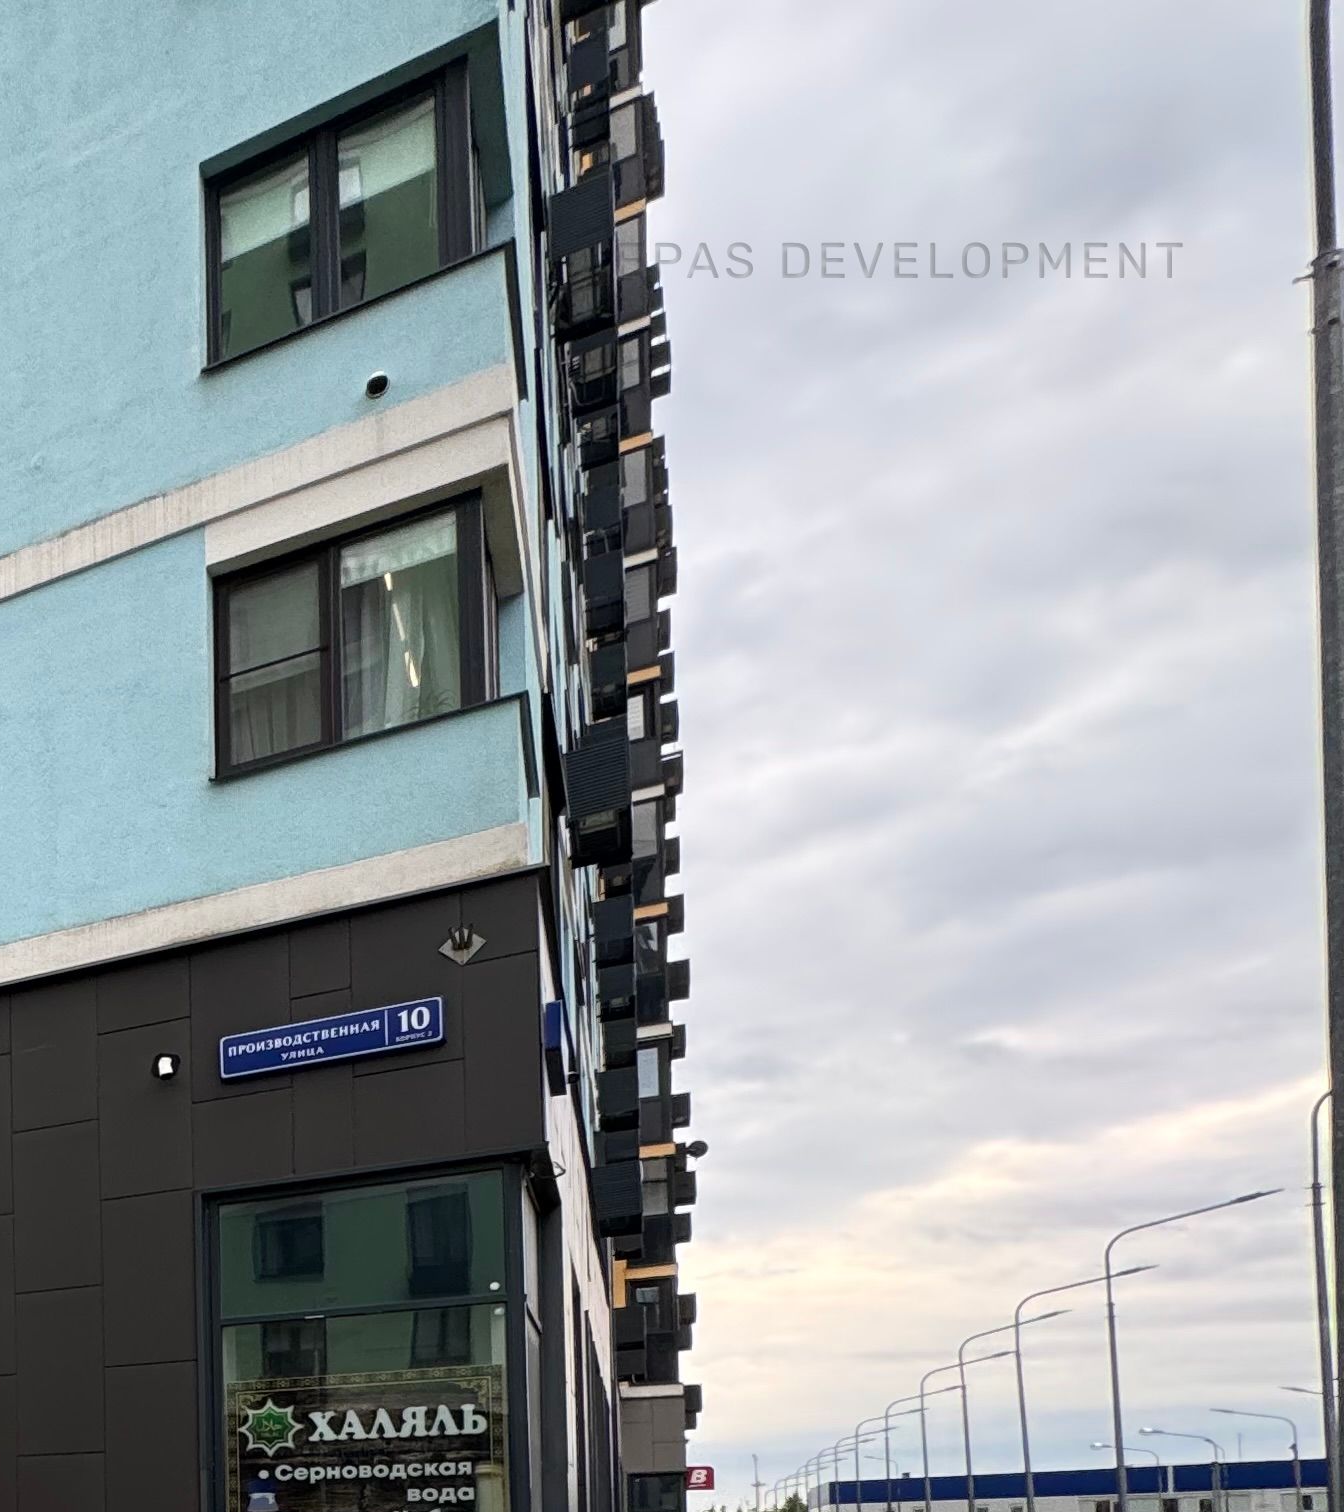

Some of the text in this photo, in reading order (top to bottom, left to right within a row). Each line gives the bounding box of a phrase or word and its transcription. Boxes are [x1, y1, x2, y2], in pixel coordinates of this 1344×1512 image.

[397, 1006, 431, 1033] 10
[227, 1019, 381, 1057] ПРОИЗВОДСТВЕННАЯ
[281, 1046, 325, 1061] УЛИЦА
[308, 1403, 489, 1442] ХАЛЯЛЬ
[274, 1461, 473, 1484] Серноводская
[407, 1486, 476, 1504] вода
